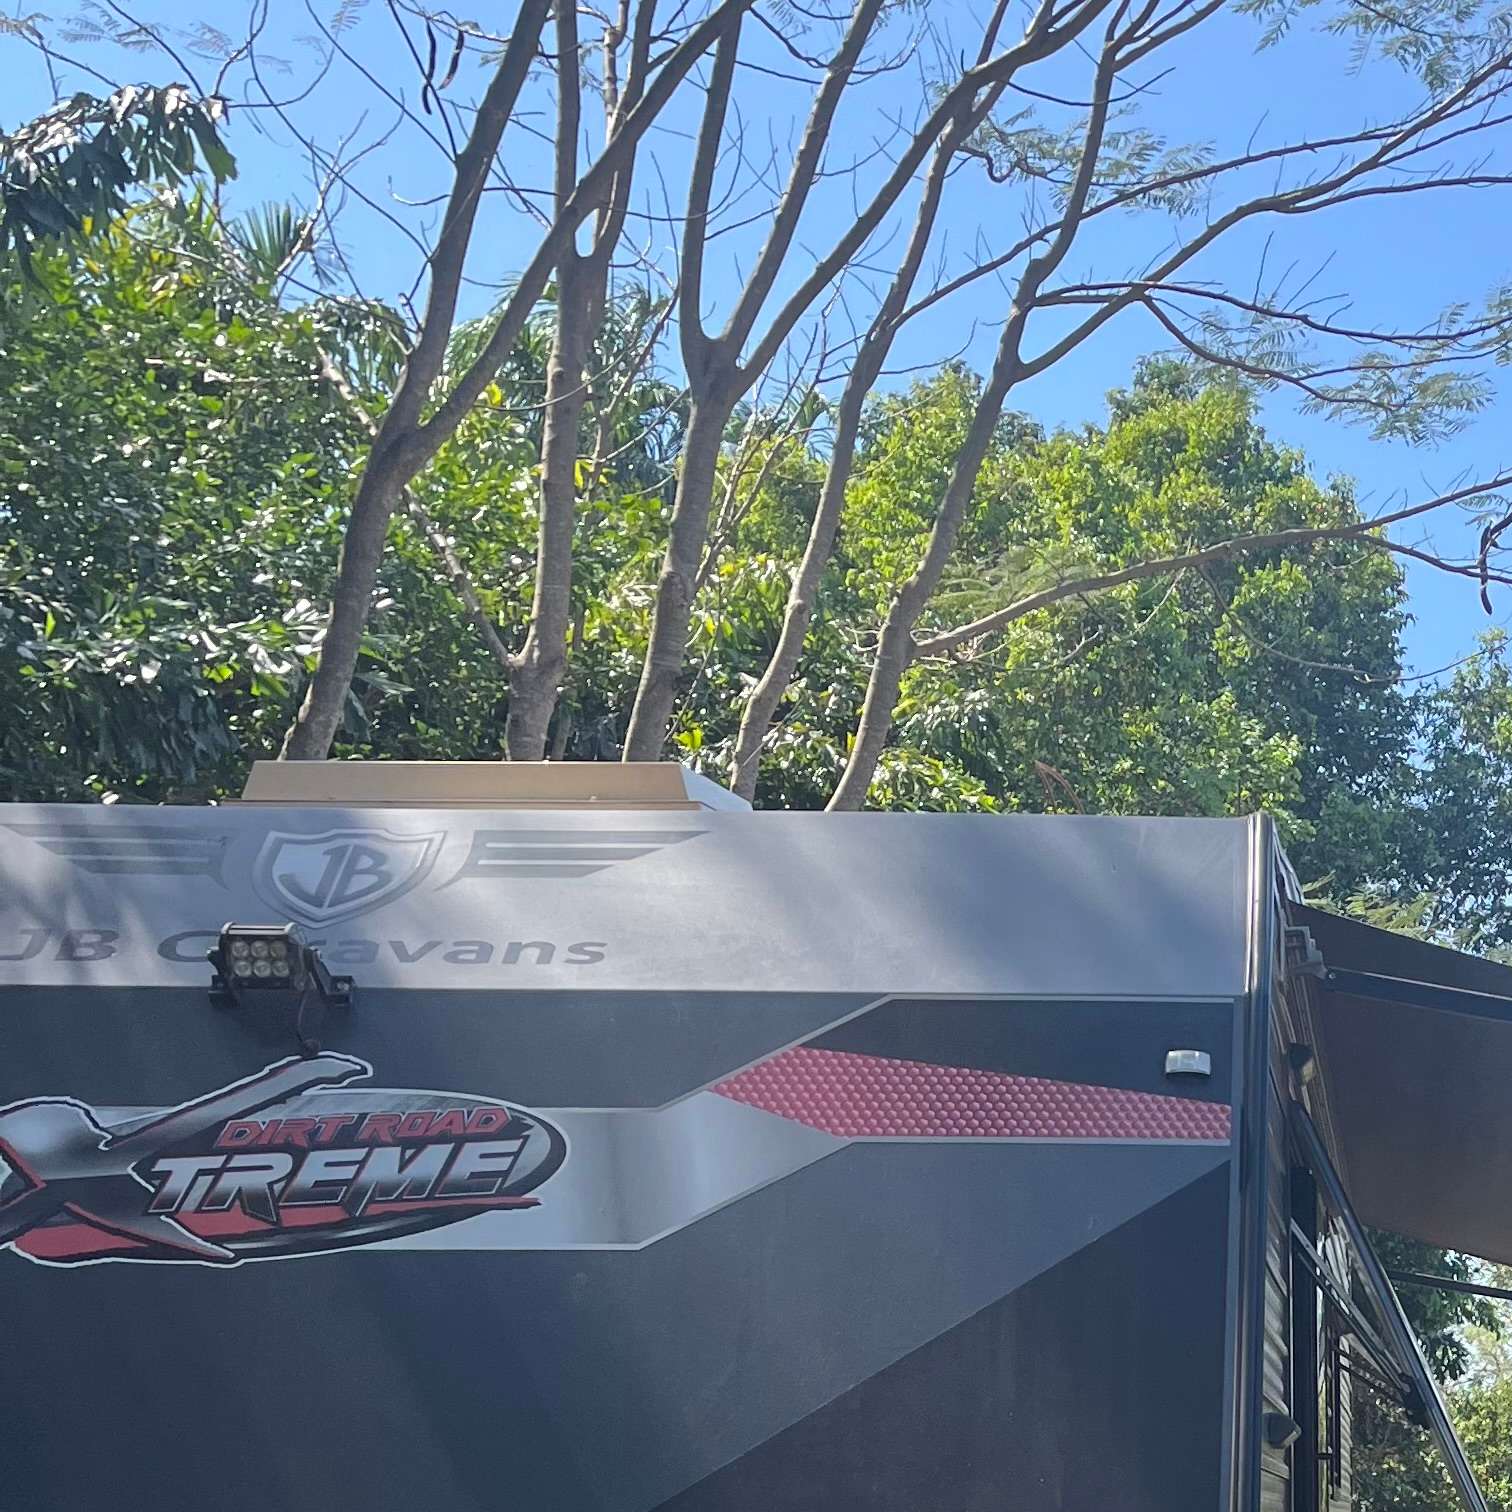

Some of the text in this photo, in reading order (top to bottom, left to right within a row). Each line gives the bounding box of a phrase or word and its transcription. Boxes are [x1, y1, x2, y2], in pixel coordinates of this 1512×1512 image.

[279, 843, 394, 909] JB
[0, 928, 608, 966] JB Cavans
[214, 1106, 511, 1148] DIRT ROAD
